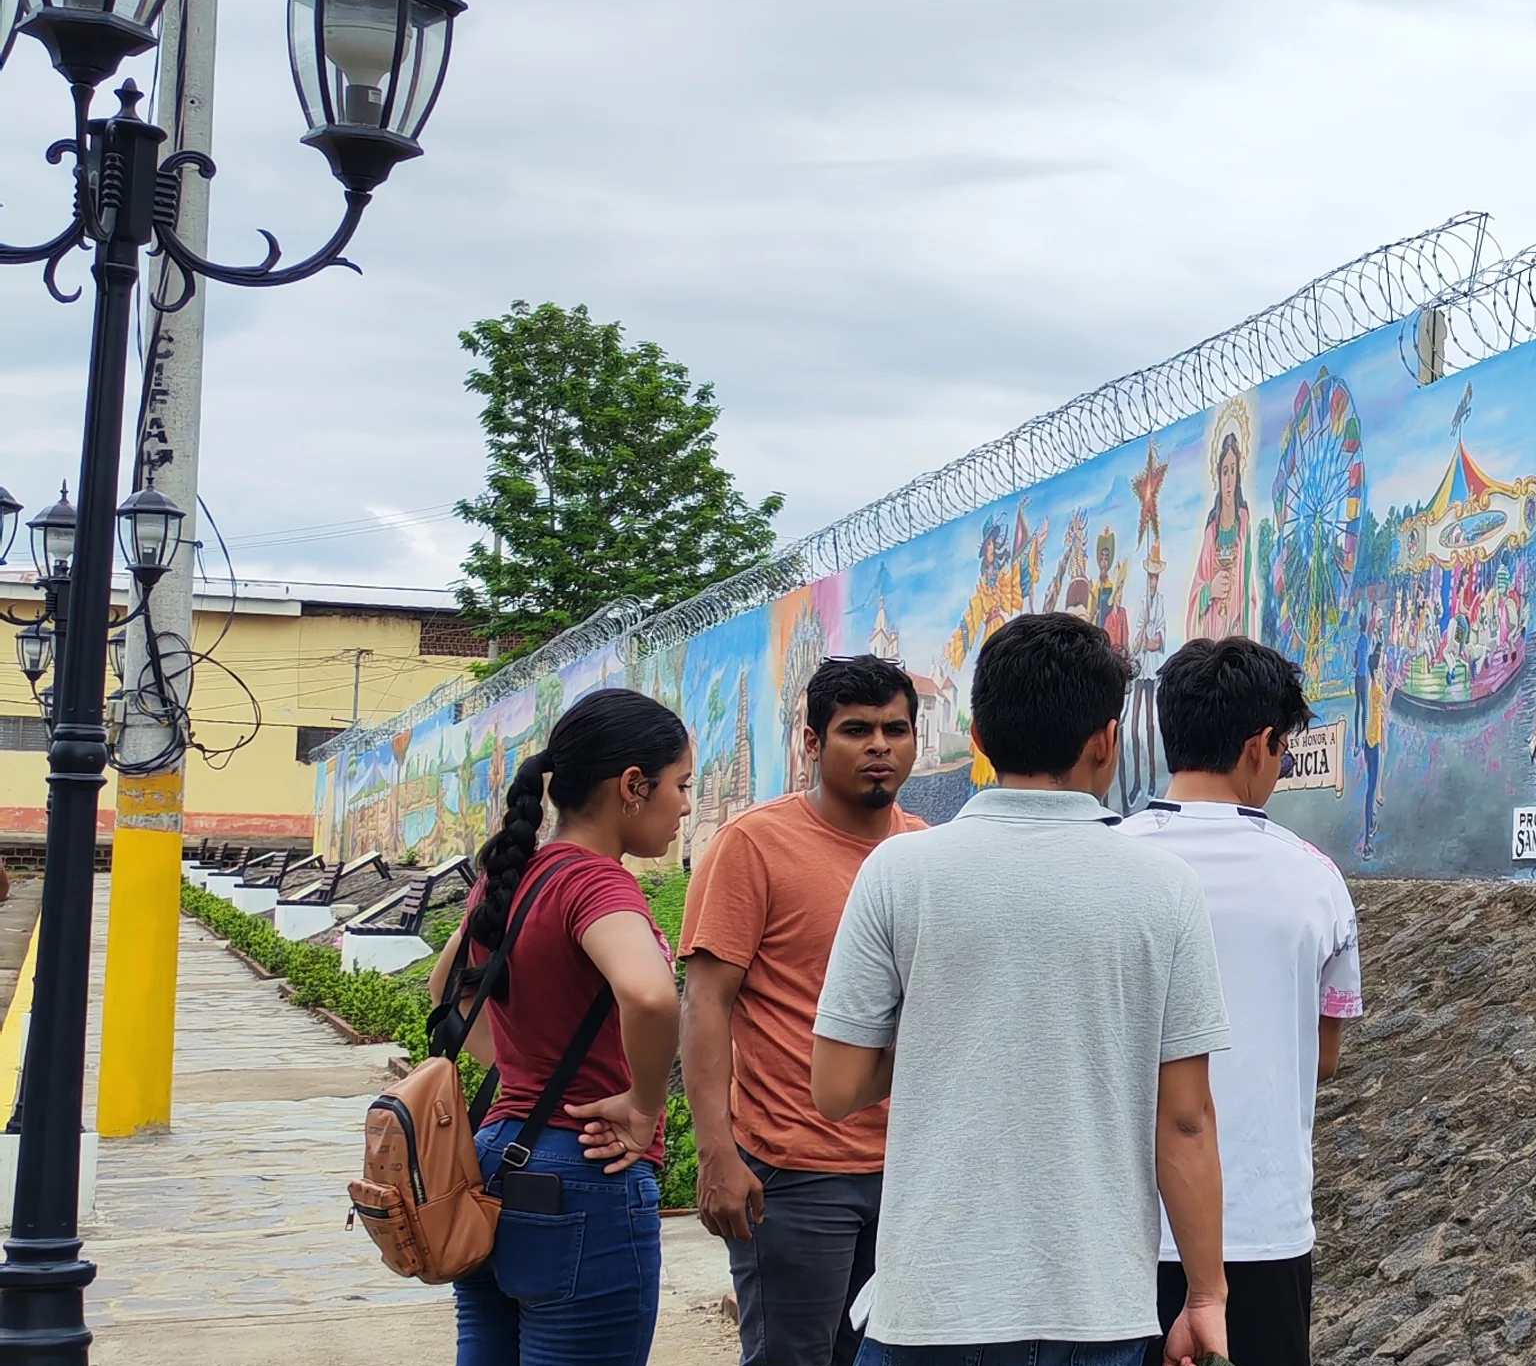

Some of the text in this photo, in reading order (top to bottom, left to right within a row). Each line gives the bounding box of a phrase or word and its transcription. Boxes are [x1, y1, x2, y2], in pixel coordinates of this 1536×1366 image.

[1290, 732, 1336, 749] EN HONOR A
